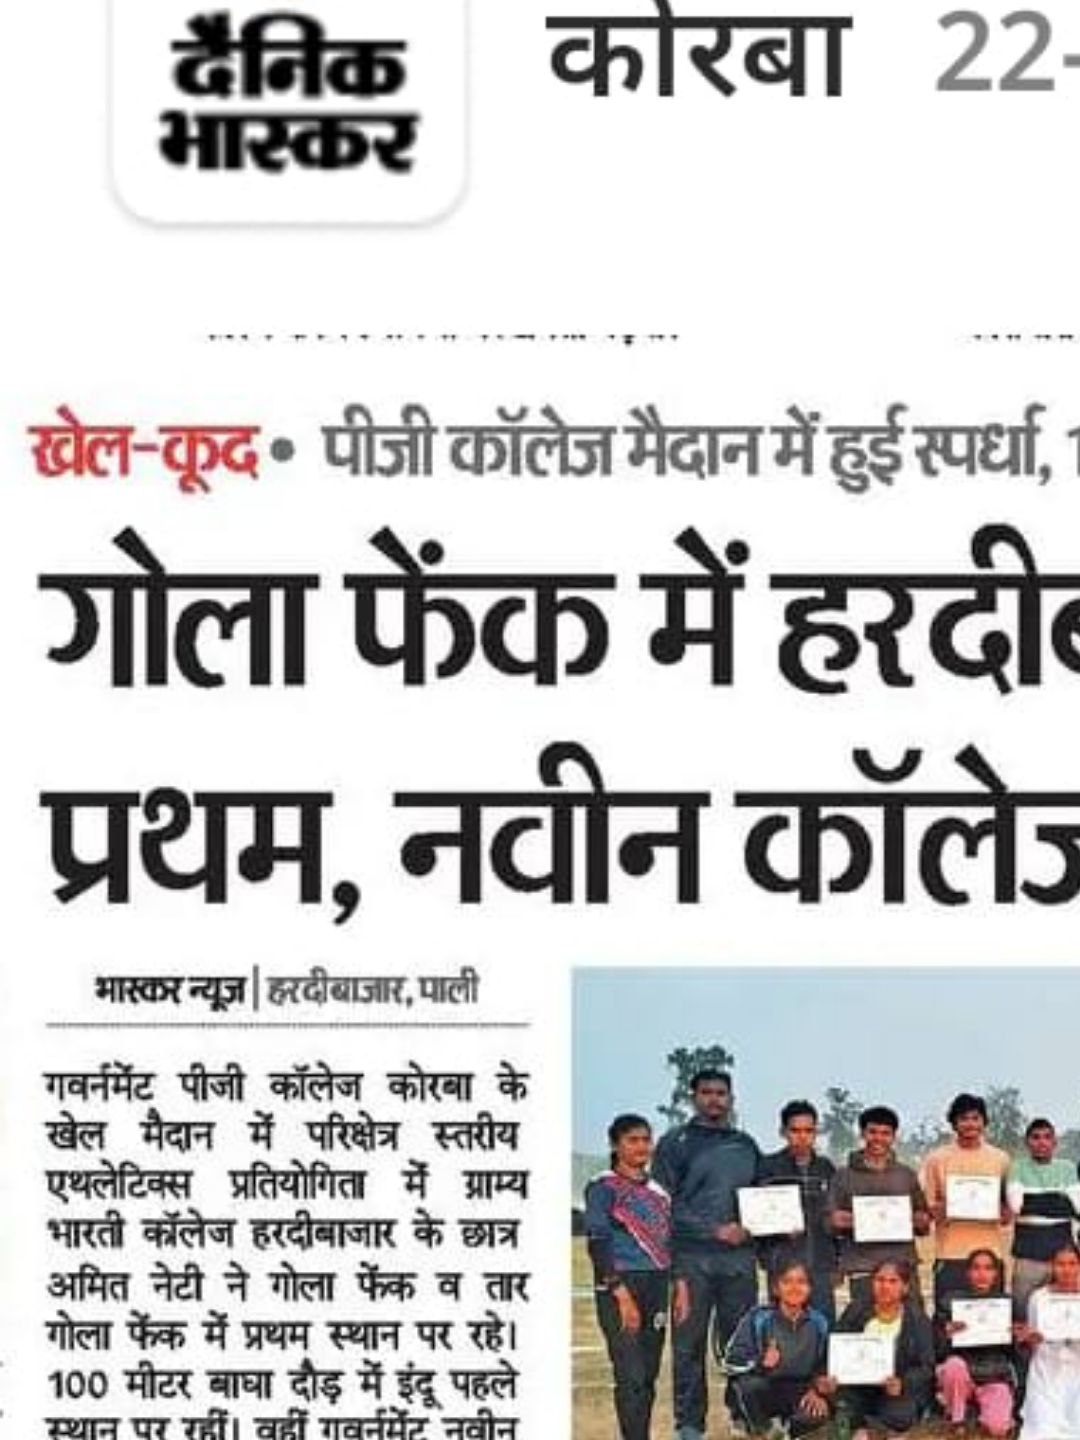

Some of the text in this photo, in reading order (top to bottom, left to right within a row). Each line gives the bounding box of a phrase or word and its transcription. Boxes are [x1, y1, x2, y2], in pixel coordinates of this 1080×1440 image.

[171, 11, 407, 99] दैनिक
[159, 110, 420, 174] भास्कर
[27, 405, 261, 494] खेल-कूद
[321, 404, 438, 477] पीजी
[446, 405, 617, 477] कॉलेज
[623, 405, 764, 479] मैदान
[770, 405, 820, 475] में
[826, 404, 907, 494] हुई
[912, 403, 1051, 485] स्पर्धा,
[38, 527, 320, 688] गोला
[343, 526, 616, 686] फेंक
[639, 527, 750, 686] में
[40, 787, 360, 925] प्रथम,
[393, 742, 711, 904] नवीन
[95, 976, 185, 1004] भास्कर
[418, 967, 479, 1004] पाली
[42, 1061, 530, 1102] गवर्नमेंट पीजी कॉलेज कोरबा के
[45, 1108, 520, 1153] खेल मैदान में परिक्षेत्र स्तरीय
